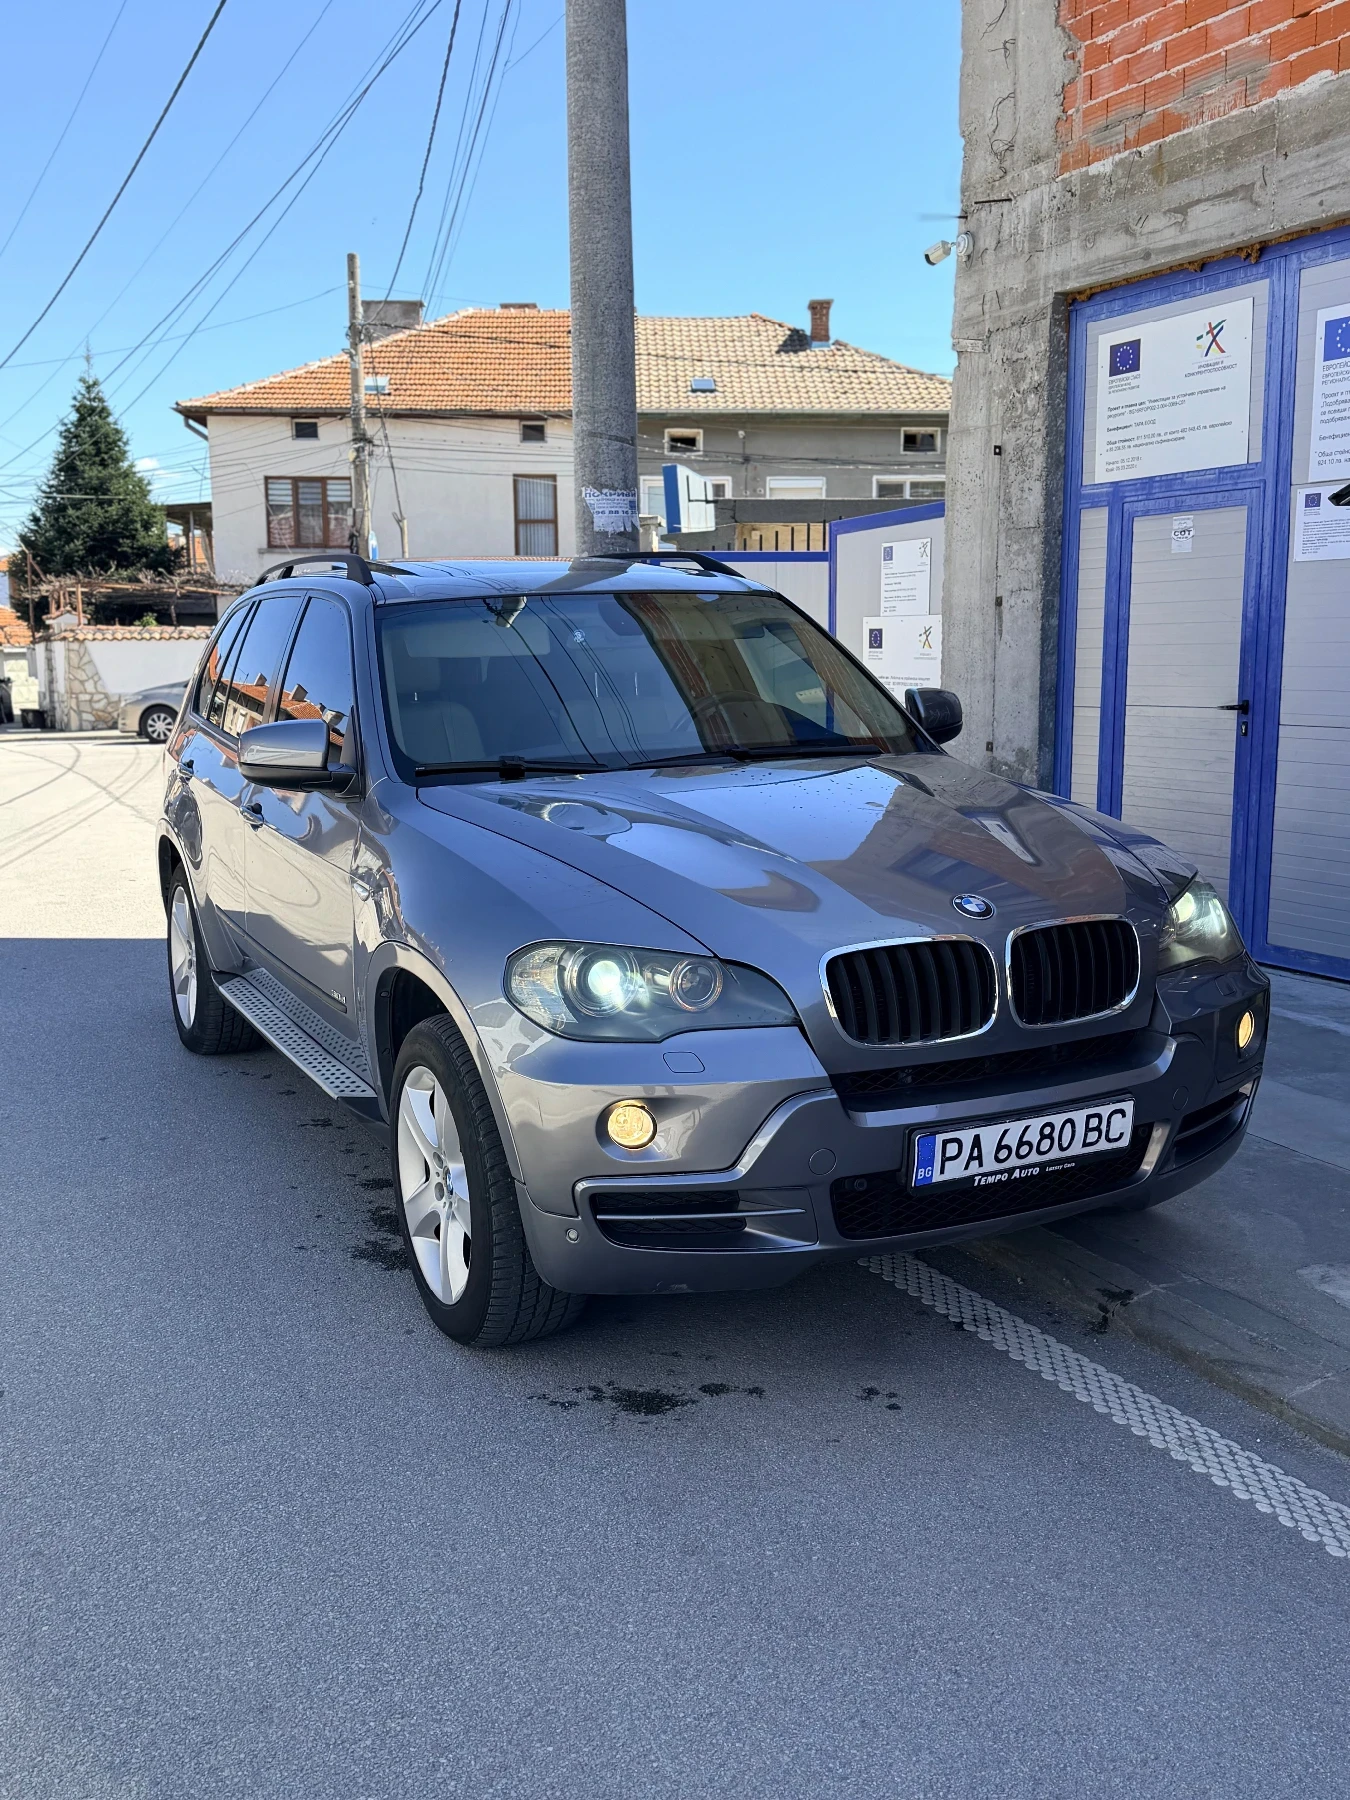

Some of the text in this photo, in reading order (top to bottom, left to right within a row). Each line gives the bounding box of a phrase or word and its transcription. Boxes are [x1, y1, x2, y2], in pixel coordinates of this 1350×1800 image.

[918, 1108, 1126, 1179] BG PA 6680 BC
